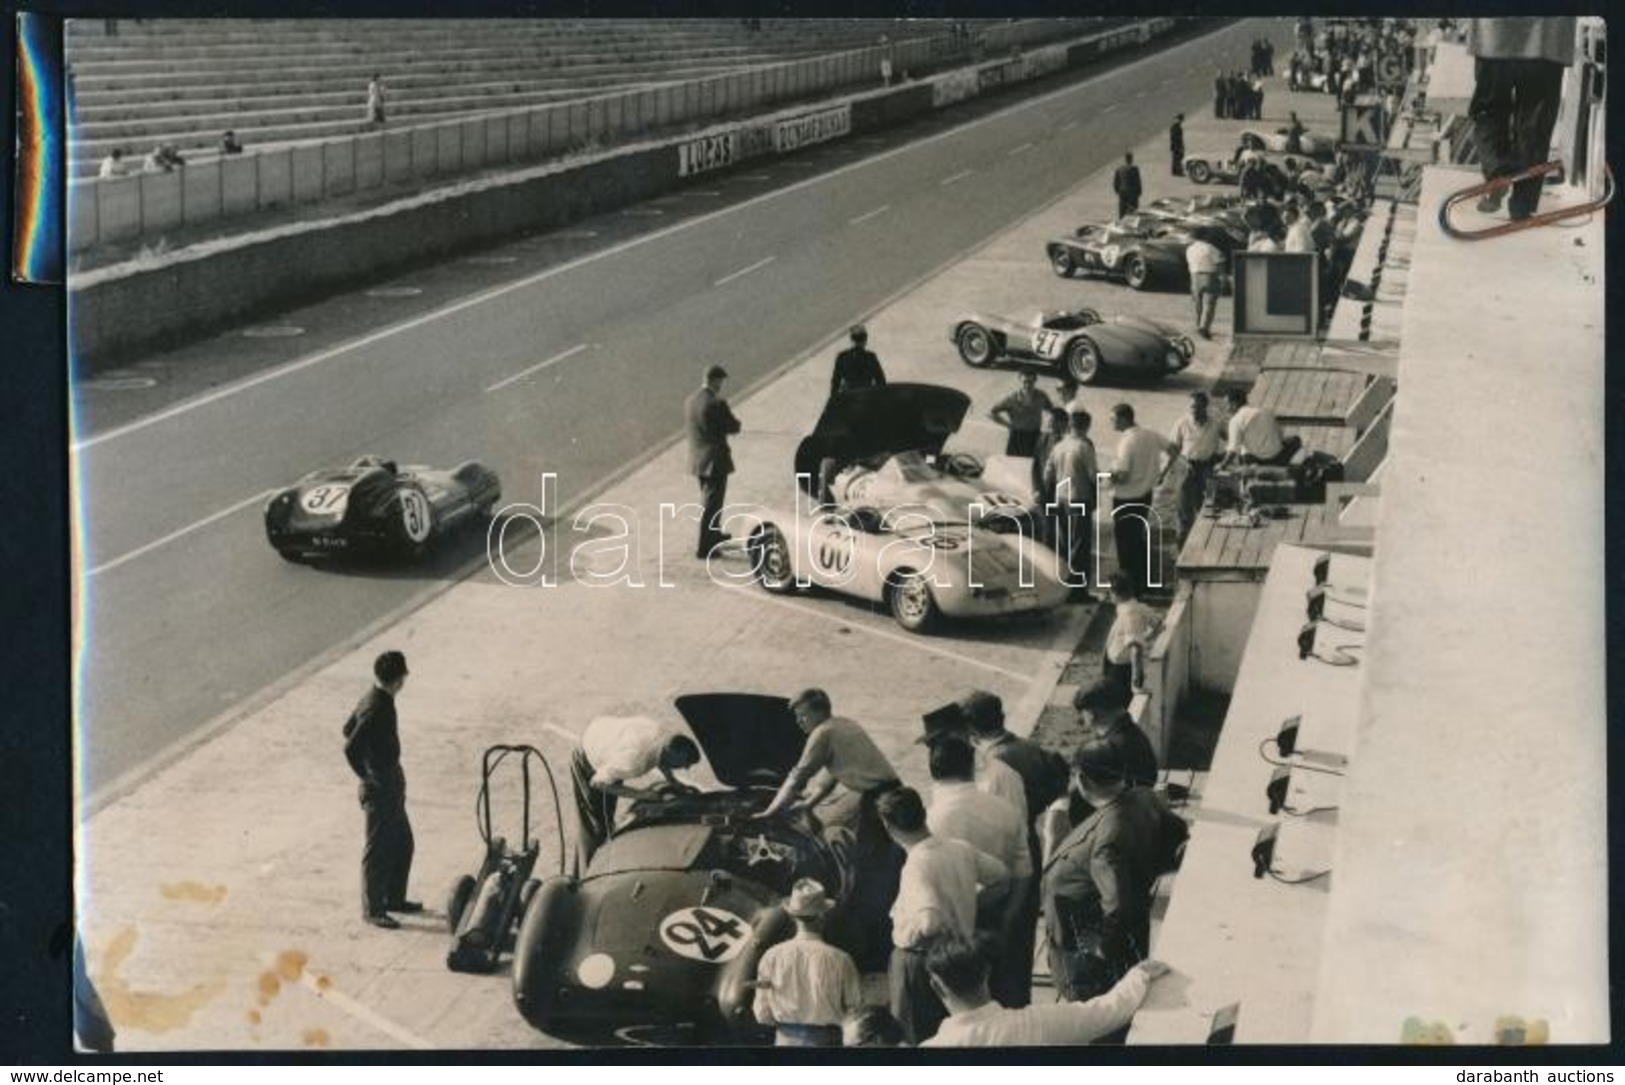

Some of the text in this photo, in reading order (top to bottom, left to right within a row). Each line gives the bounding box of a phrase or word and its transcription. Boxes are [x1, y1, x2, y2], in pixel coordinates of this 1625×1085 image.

[1381, 56, 1400, 80] G
[1346, 107, 1379, 143] K
[687, 133, 731, 174] LUCAS
[1245, 257, 1306, 332] L
[1035, 330, 1060, 356] 27
[308, 486, 349, 509] 37
[665, 908, 745, 961] 24
